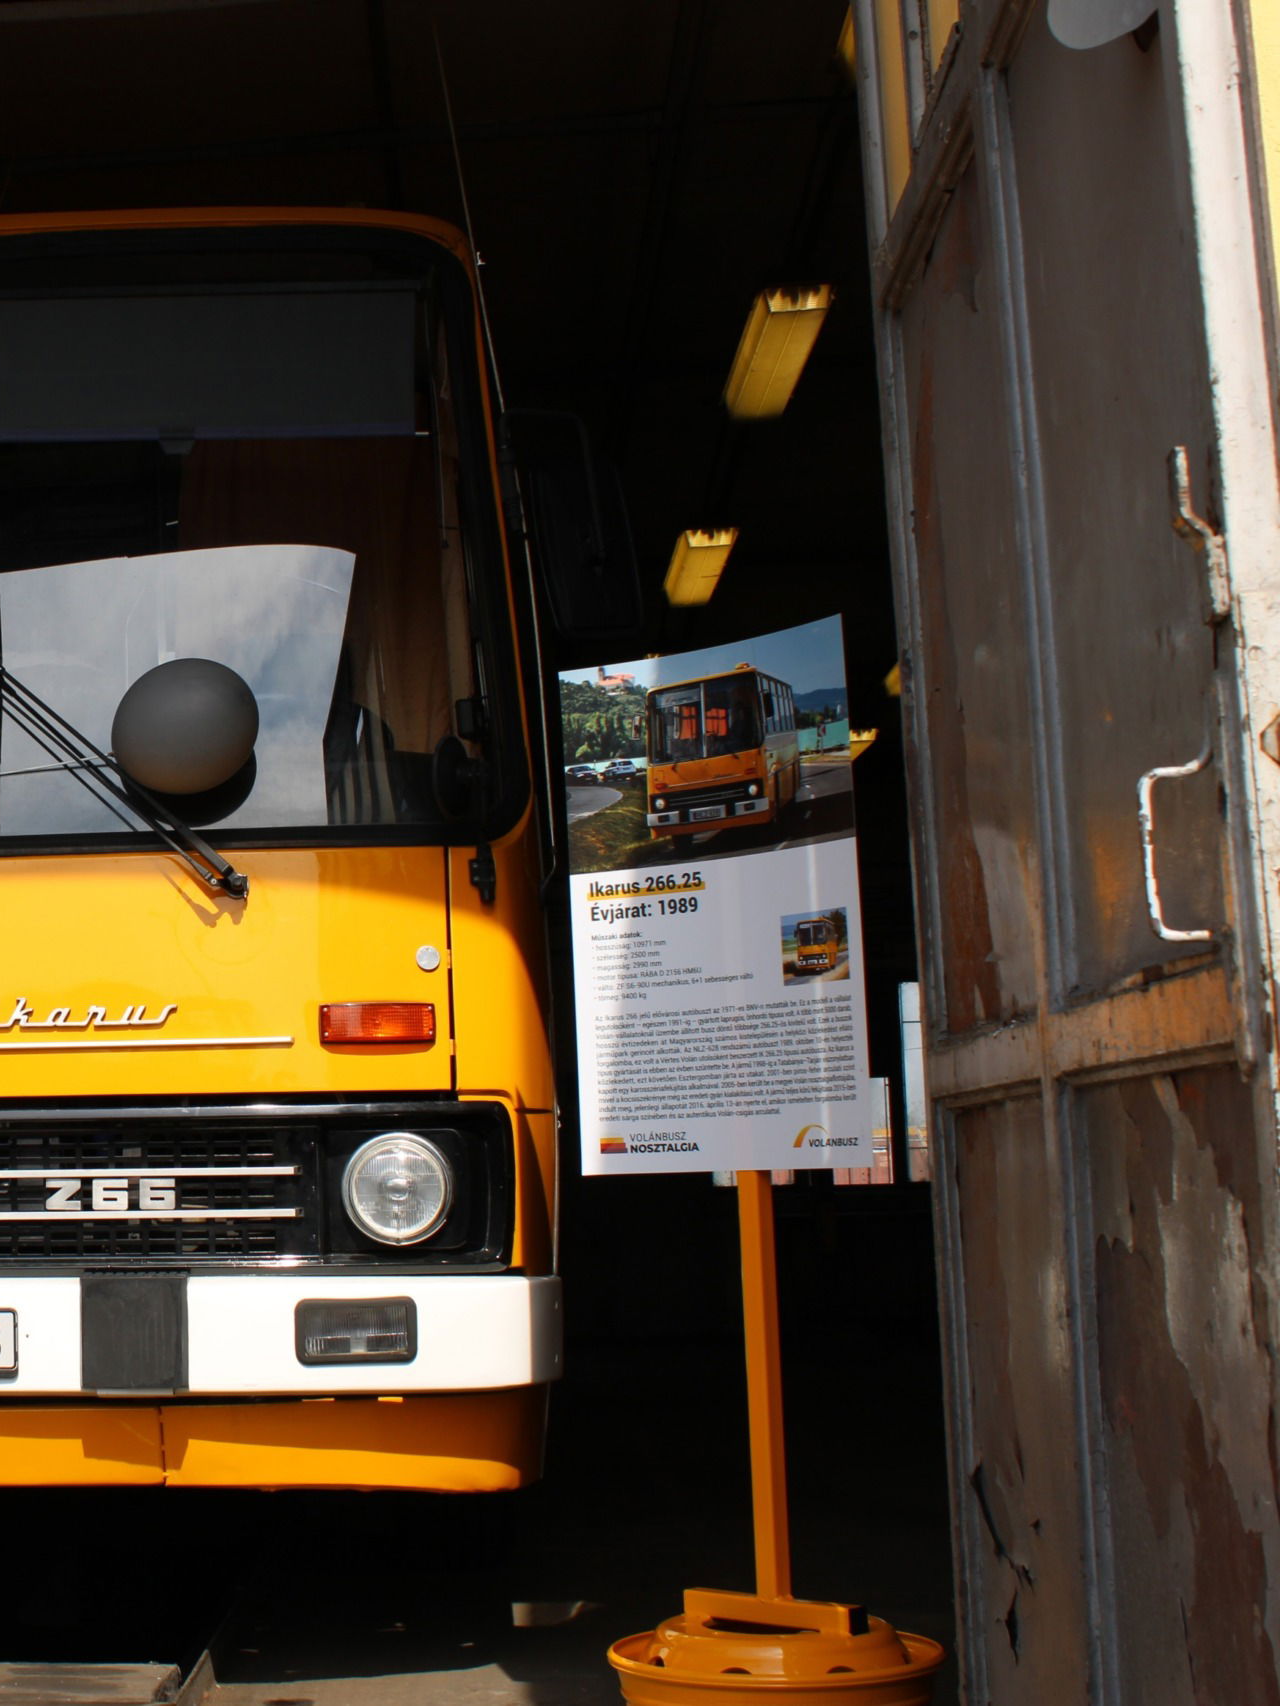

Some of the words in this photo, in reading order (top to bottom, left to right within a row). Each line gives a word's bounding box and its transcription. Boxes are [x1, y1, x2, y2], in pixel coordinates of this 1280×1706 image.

[589, 878, 641, 898] Ikarus
[645, 871, 702, 892] 266.25
[590, 902, 653, 924] Évjárat:
[658, 896, 699, 916] 1989
[630, 1142, 700, 1154] NOSZTALGIA
